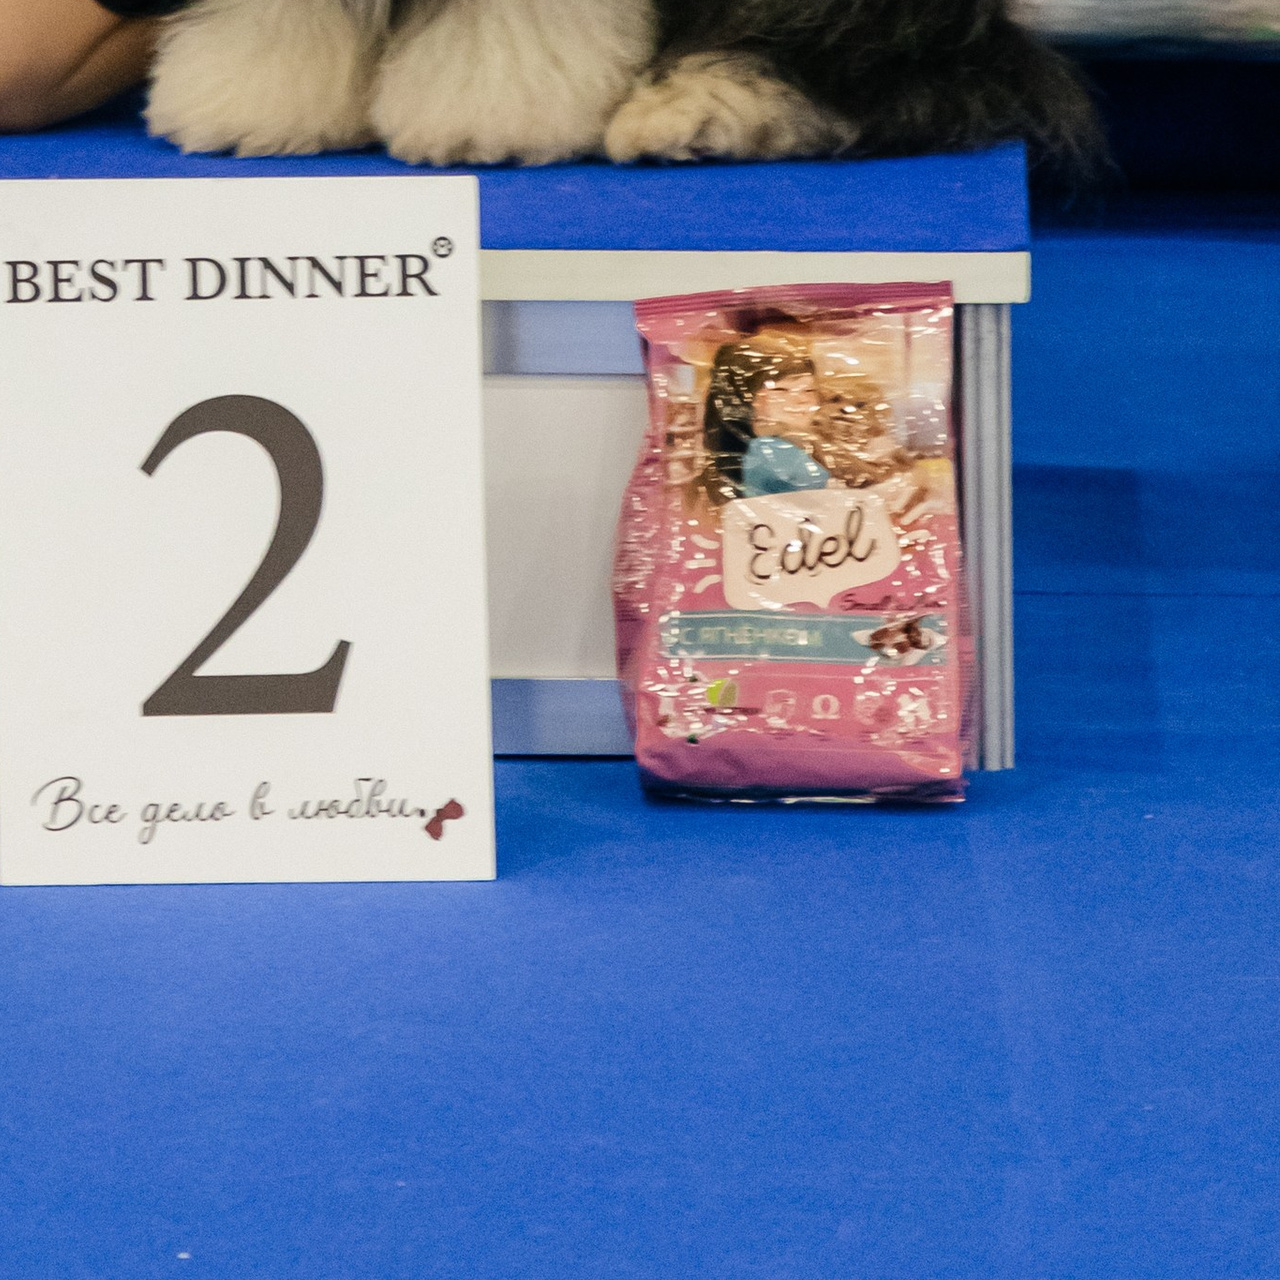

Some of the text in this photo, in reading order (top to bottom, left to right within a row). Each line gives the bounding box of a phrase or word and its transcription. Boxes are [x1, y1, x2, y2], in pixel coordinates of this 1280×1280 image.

[5, 253, 440, 303] BEST DINNER
[140, 394, 351, 716] 2
[750, 507, 877, 582] Edel
[30, 775, 128, 832] Все
[140, 801, 235, 844] дело
[250, 781, 276, 820] в
